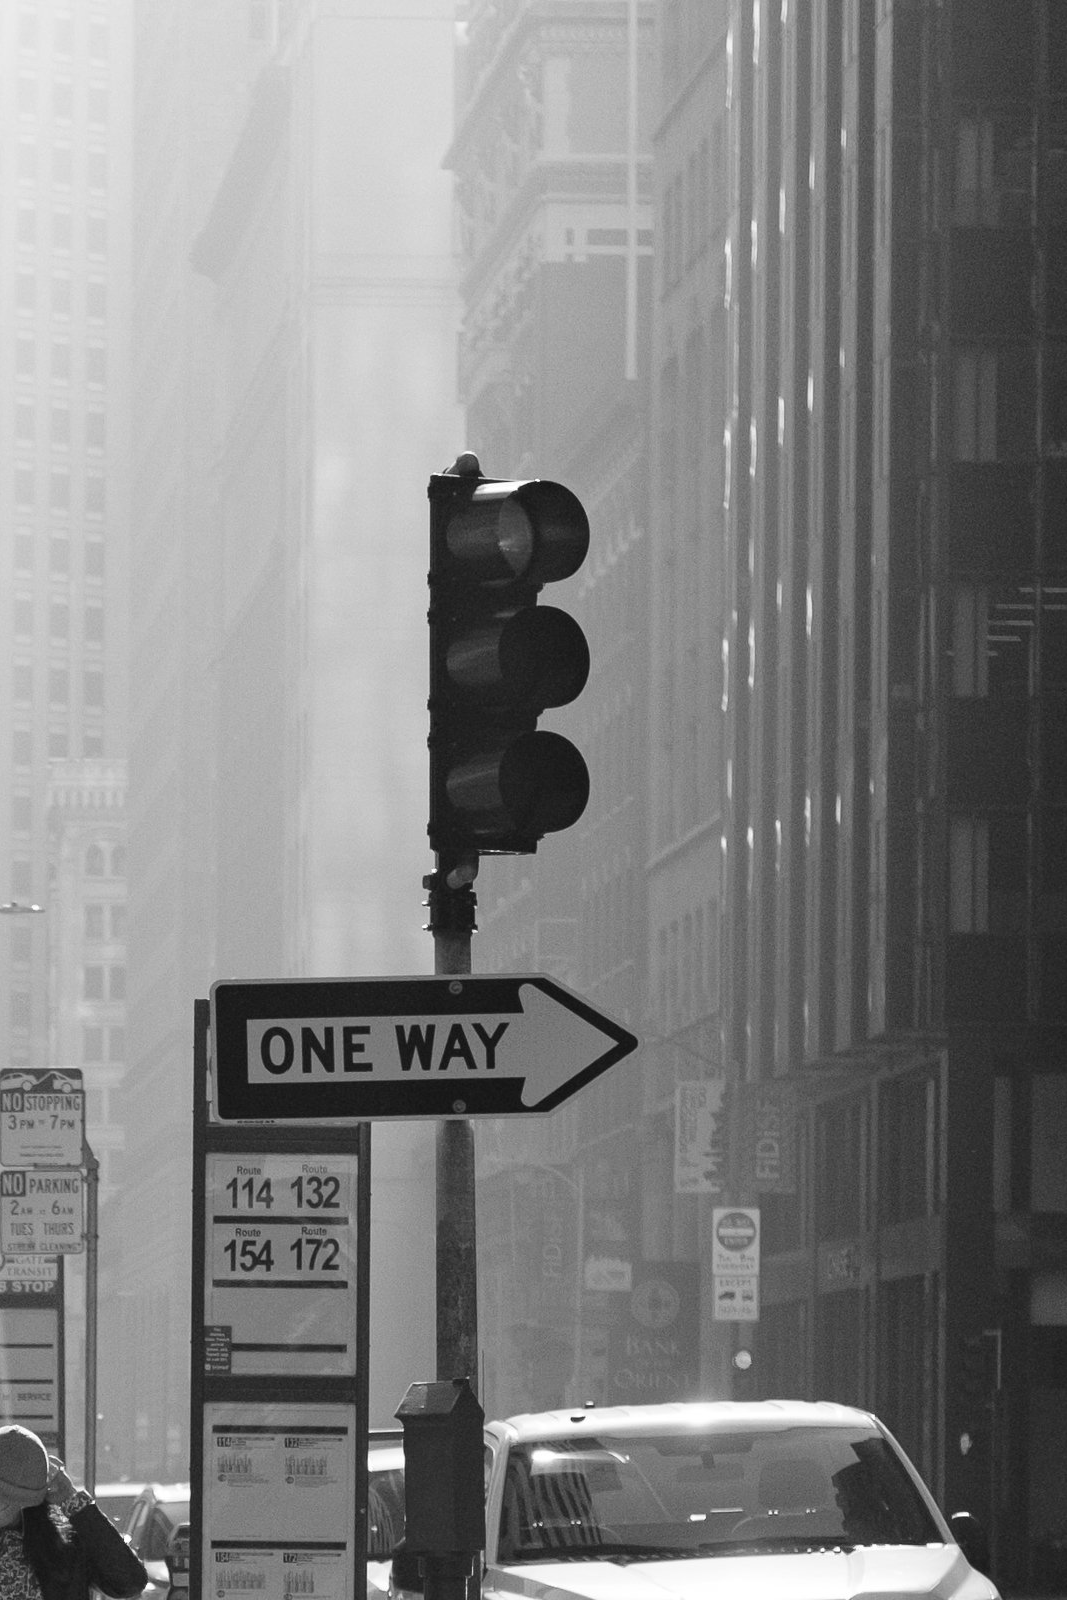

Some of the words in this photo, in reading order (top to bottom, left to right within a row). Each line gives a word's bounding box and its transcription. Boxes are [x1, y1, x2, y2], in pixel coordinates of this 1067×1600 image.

[260, 1026, 373, 1075] ONE
[395, 1022, 510, 1071] WAY
[1, 1093, 22, 1111] NO
[25, 1094, 81, 1111] STOPPING
[236, 1165, 261, 1175] Route
[301, 1164, 328, 1174] Route
[1, 1173, 24, 1195] NO
[29, 1178, 80, 1194] PARKING
[226, 1177, 274, 1209] 114
[290, 1176, 340, 1209] 132
[10, 1222, 34, 1235] TUES
[43, 1222, 75, 1235] THURS
[235, 1228, 261, 1238] Route
[301, 1226, 328, 1236] Route
[39, 1242, 78, 1251] CLEANING
[223, 1239, 274, 1272] 154
[290, 1238, 340, 1270] 172
[7, 1267, 54, 1277] TRANSIT
[11, 1281, 54, 1293] STOP
[626, 1336, 680, 1355] BANK
[217, 1437, 232, 1447] 114
[284, 1438, 299, 1448] 132
